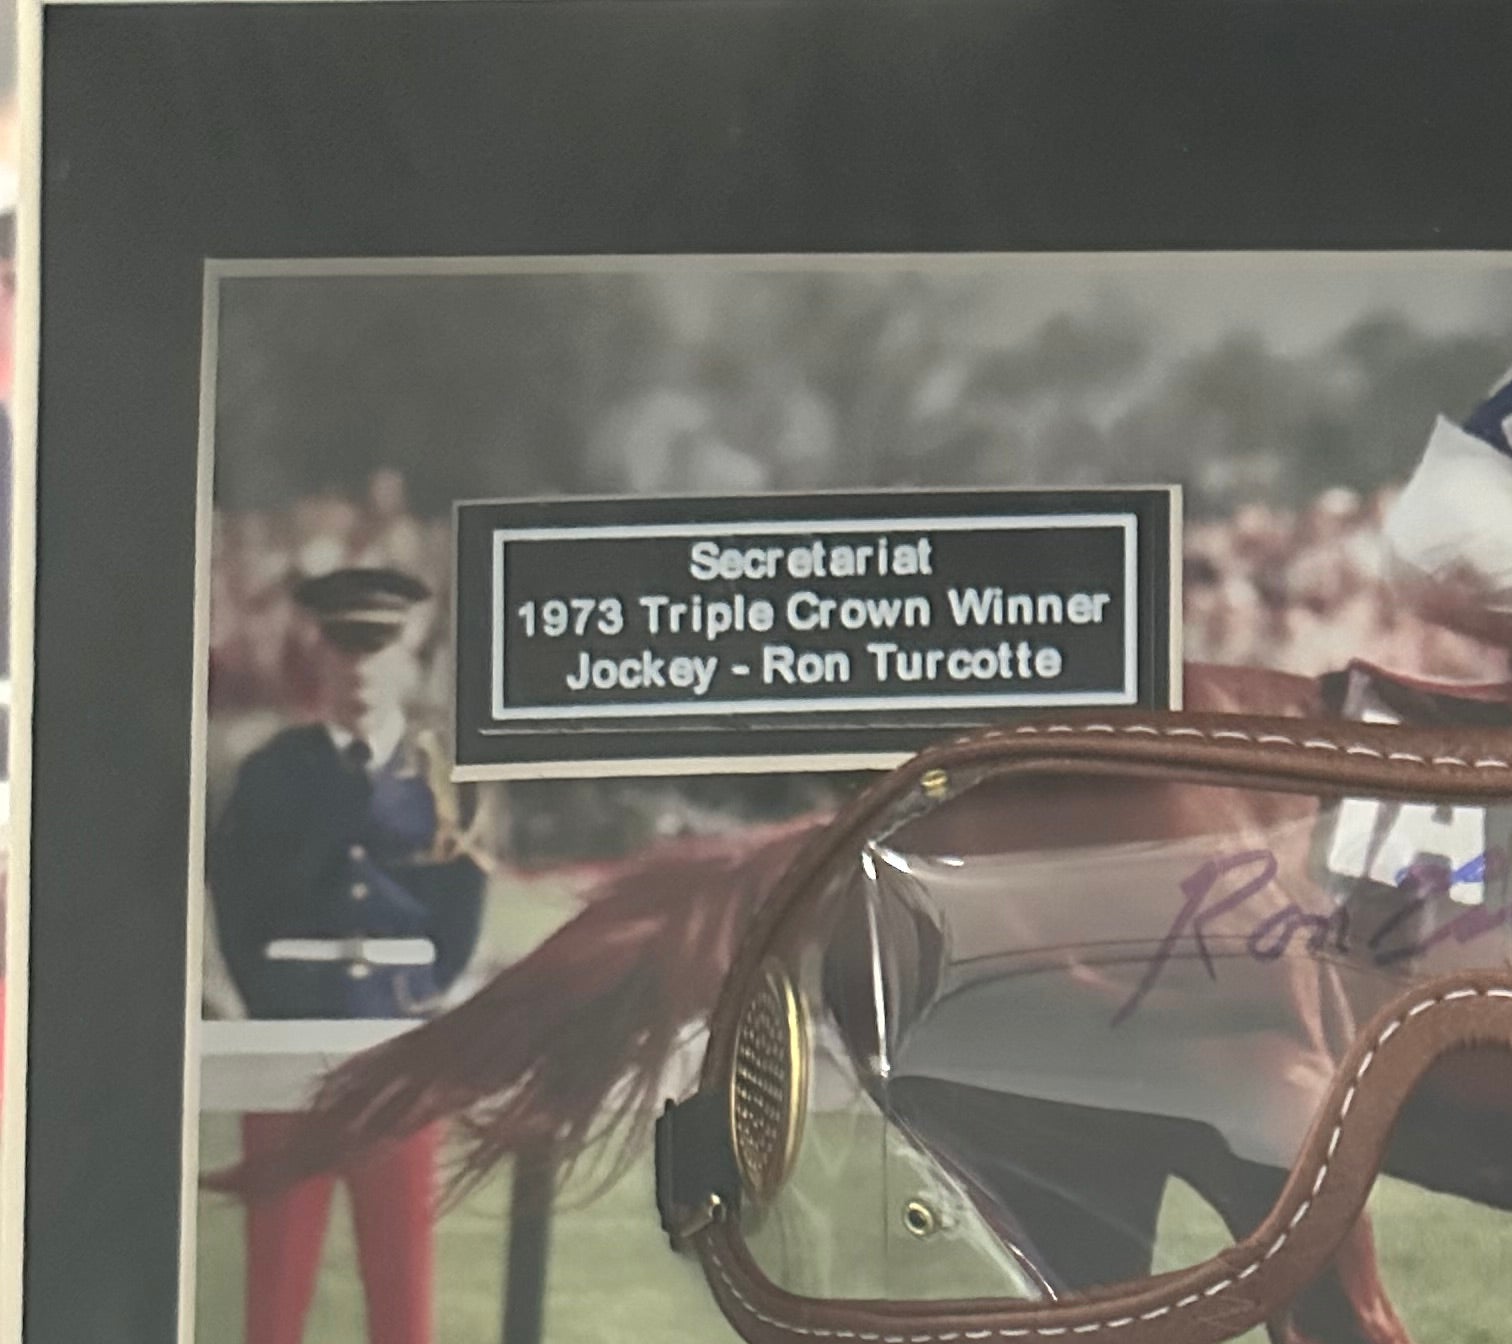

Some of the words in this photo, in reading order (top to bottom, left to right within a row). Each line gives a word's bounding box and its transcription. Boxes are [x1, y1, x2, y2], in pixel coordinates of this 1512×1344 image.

[690, 537, 932, 580] Secretariat
[518, 598, 623, 636] 1973
[639, 594, 773, 640] Triple
[787, 592, 930, 630] Crown
[948, 588, 1110, 625] Winner
[566, 650, 717, 695] Jockey
[731, 665, 749, 675] -
[763, 645, 849, 683] Ron
[867, 642, 1061, 681] Turcotte
